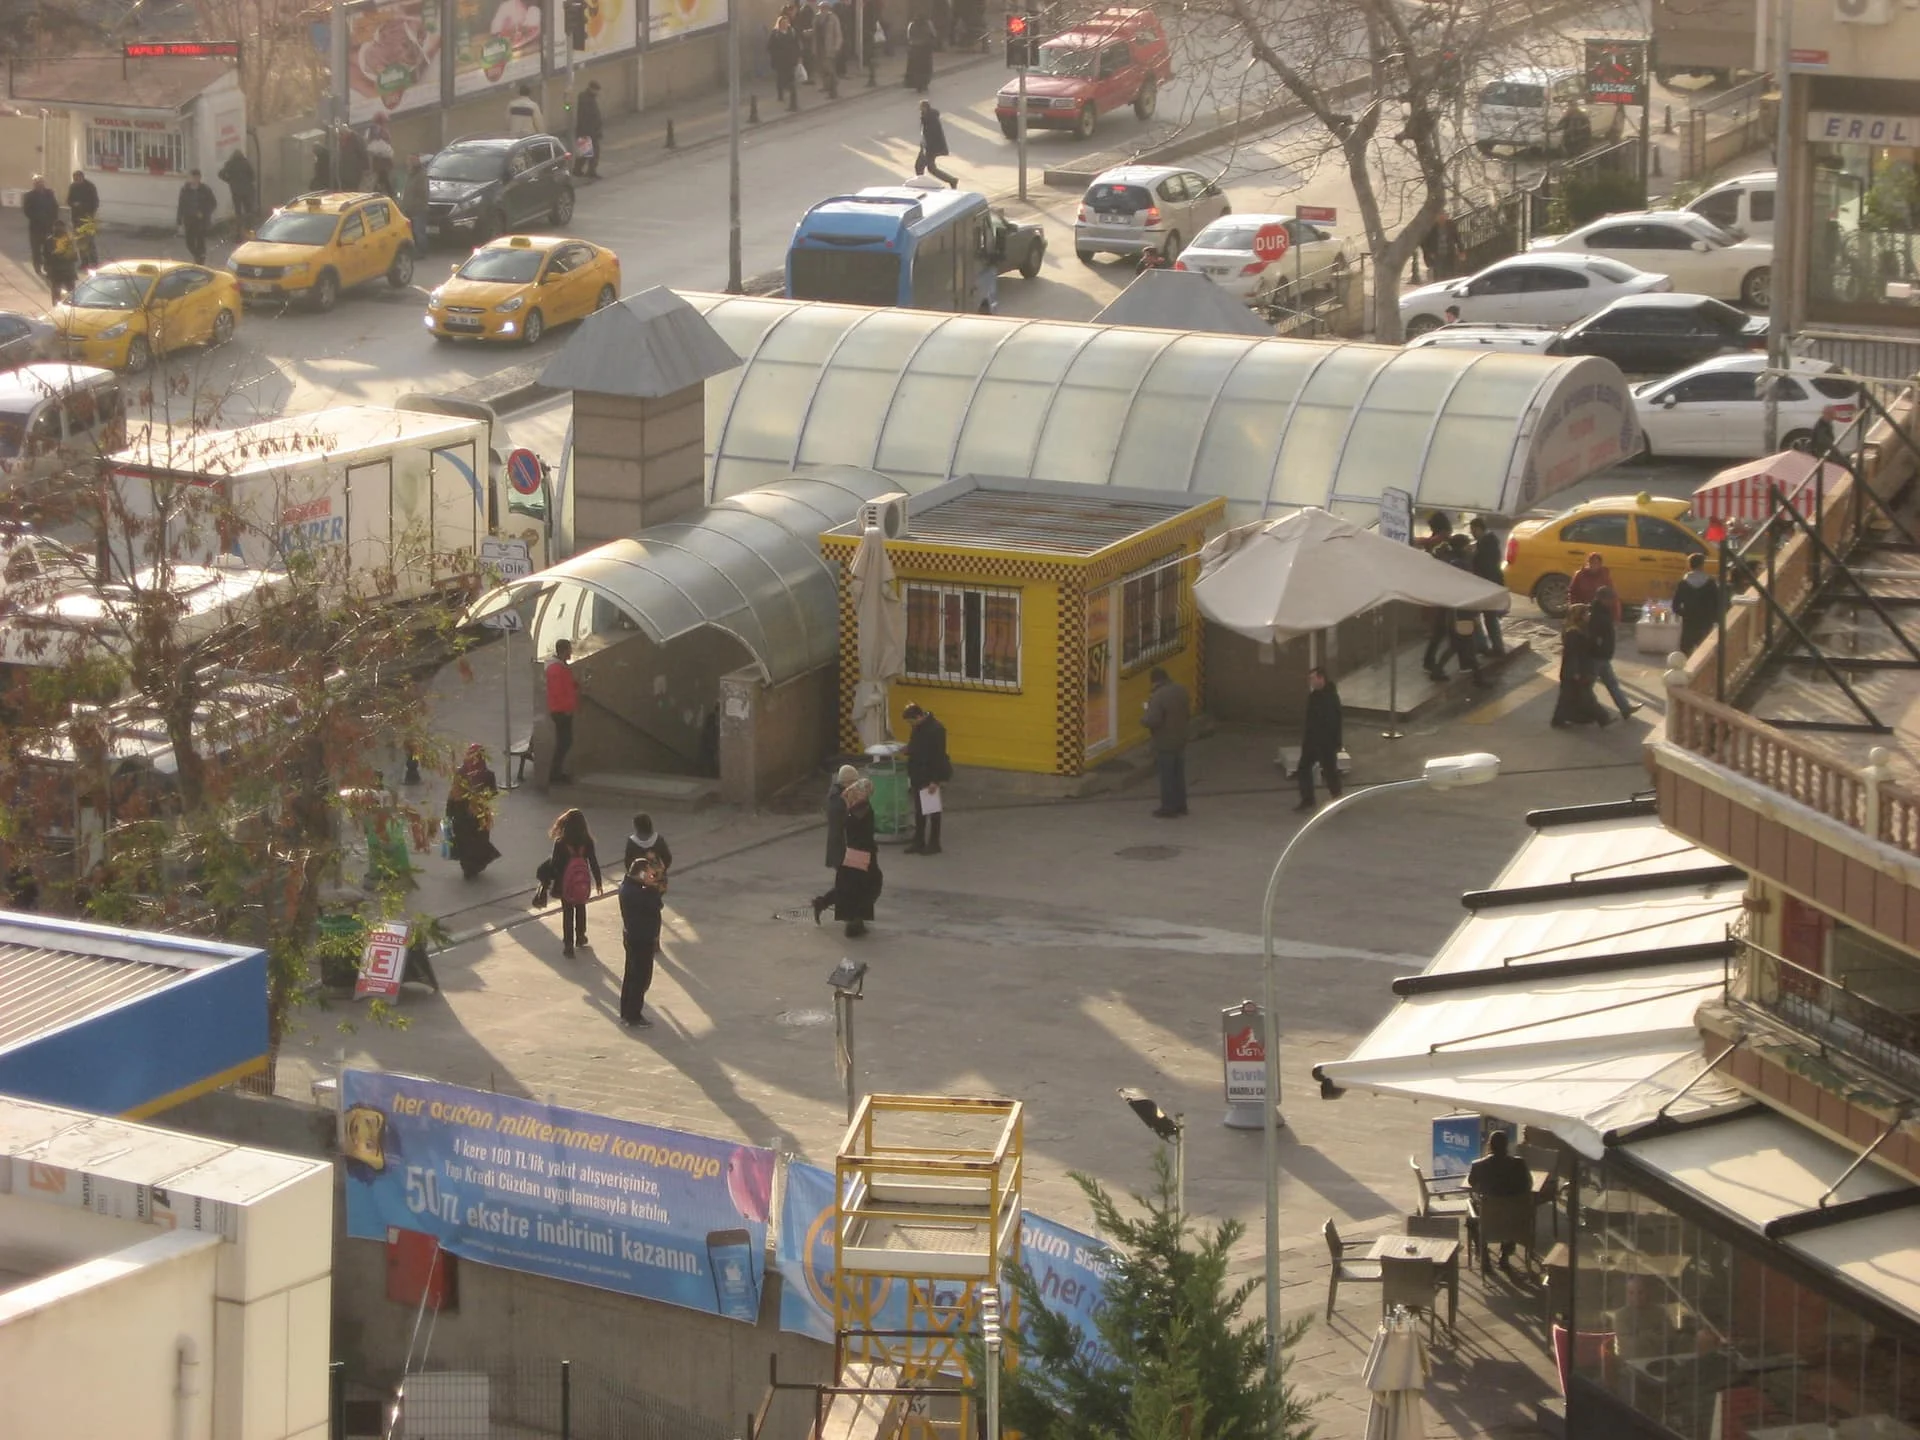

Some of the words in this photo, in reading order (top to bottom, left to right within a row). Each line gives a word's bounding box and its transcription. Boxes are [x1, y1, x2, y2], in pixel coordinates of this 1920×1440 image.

[1825, 117, 1907, 141] EROL
[1256, 235, 1286, 251] DUR
[372, 949, 392, 974] E
[392, 1091, 425, 1116] her
[430, 1101, 494, 1130] açıdan
[496, 1113, 609, 1153] mükemmel
[611, 1135, 721, 1179] kampanya
[444, 1160, 463, 1184] Yapı
[465, 1166, 495, 1187] Kredi
[499, 1172, 541, 1197] Cüzdan
[544, 1186, 627, 1216] uygulamasıyla
[631, 1200, 671, 1225] katılın.
[463, 1139, 487, 1161] kere
[492, 1147, 511, 1167] 100
[515, 1150, 545, 1173] TL'lik
[547, 1161, 577, 1179] yakıt
[579, 1165, 661, 1198] alışverişinize,
[467, 1202, 529, 1239] ekstre
[536, 1214, 615, 1257] indirimi
[620, 1231, 703, 1277] kazanın.
[1041, 1265, 1087, 1308] her
